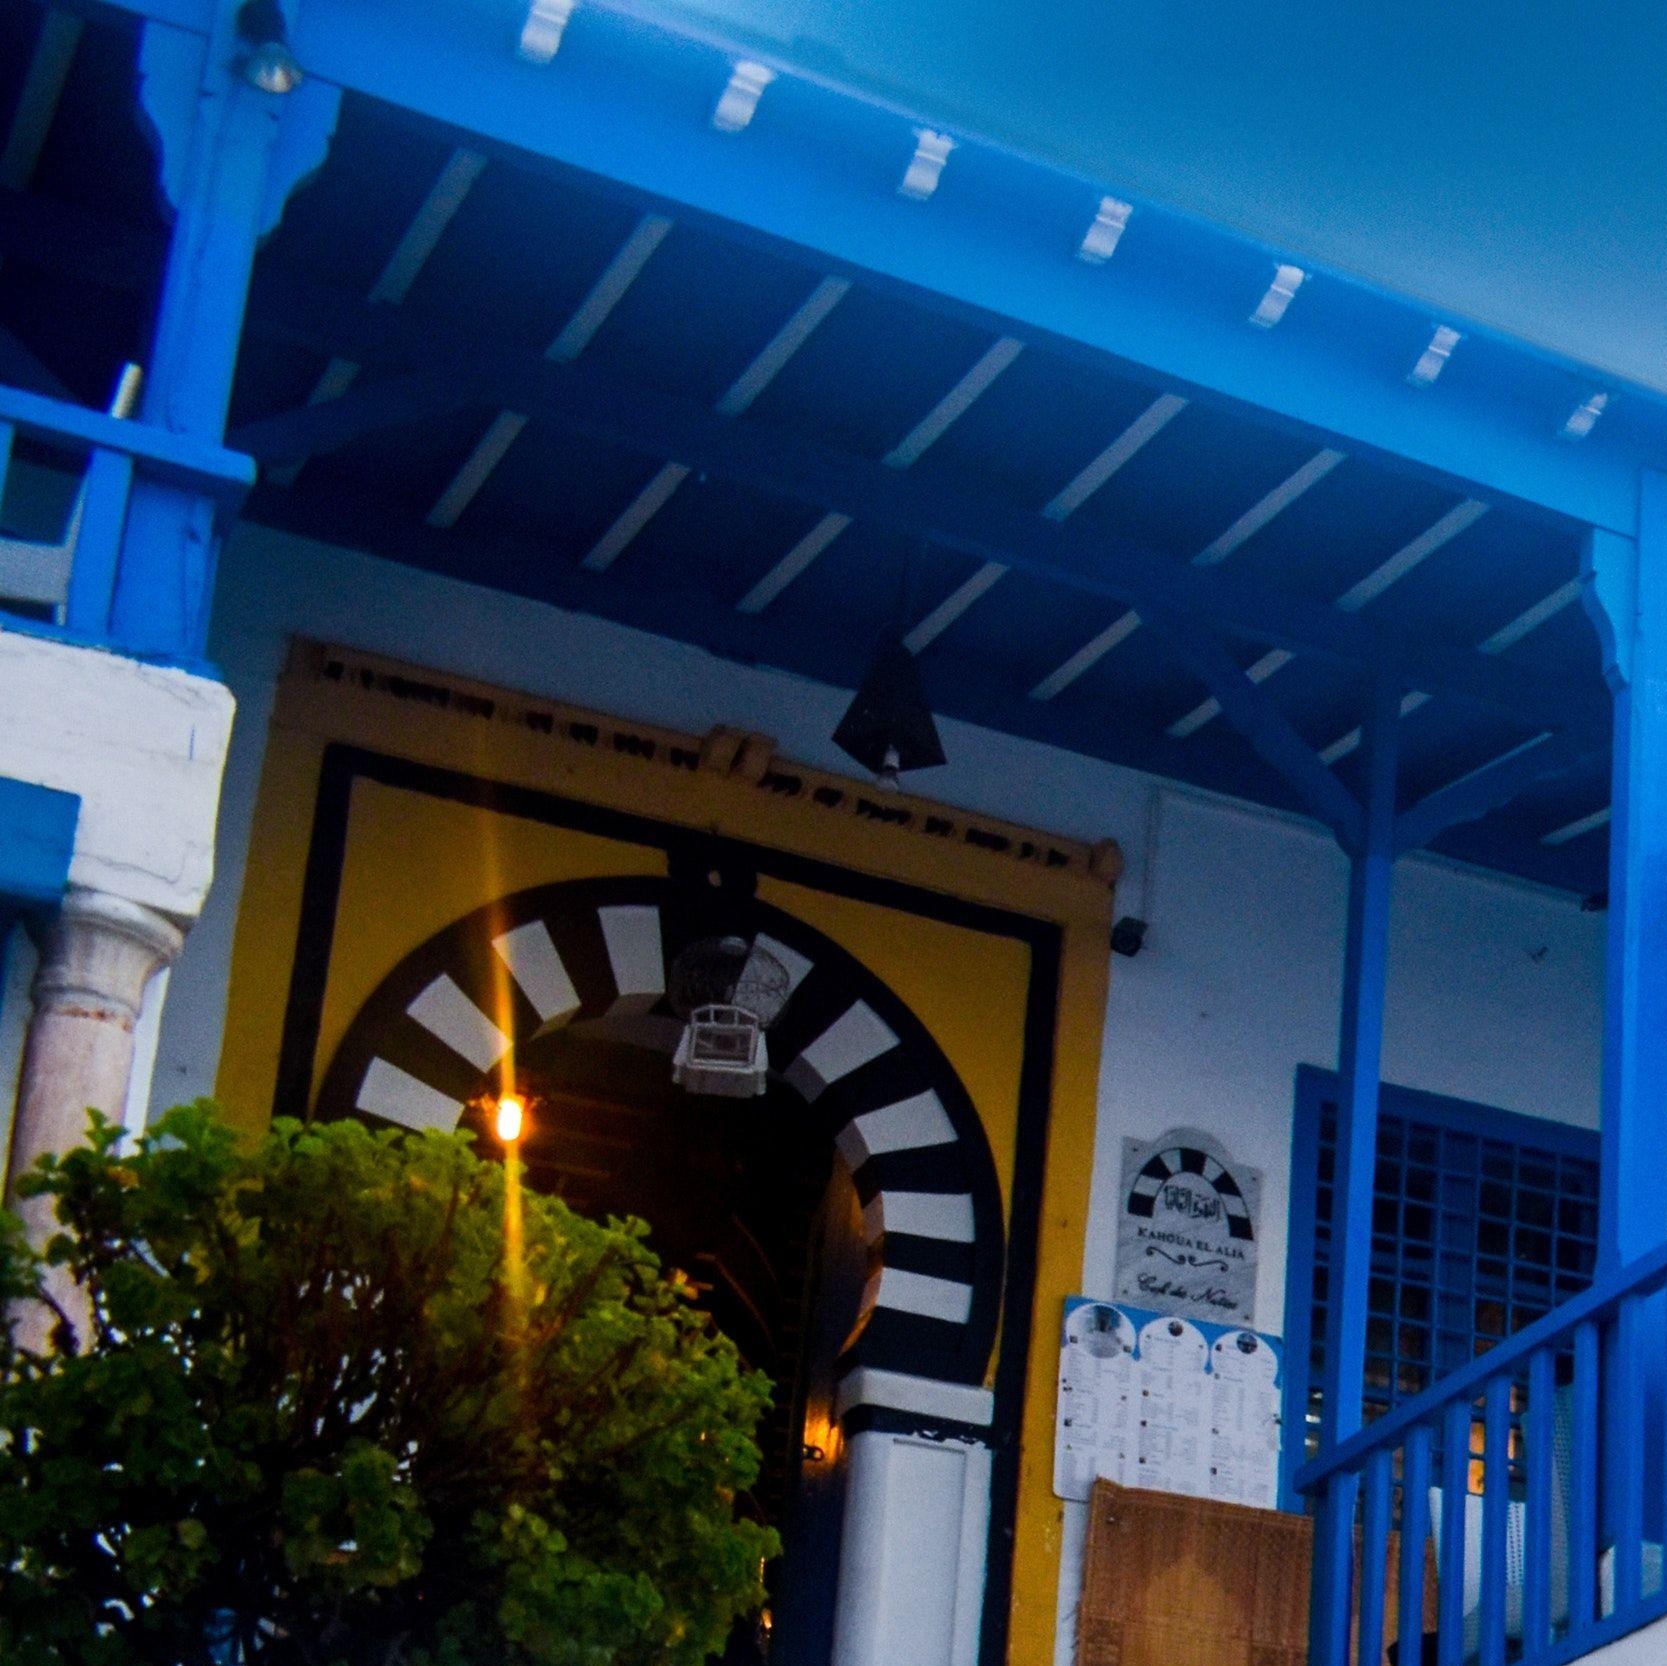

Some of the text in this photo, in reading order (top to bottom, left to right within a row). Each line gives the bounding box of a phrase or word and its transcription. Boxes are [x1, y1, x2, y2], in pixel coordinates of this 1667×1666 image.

[1137, 1227, 1245, 1259] KAHOUA EL ALIA
